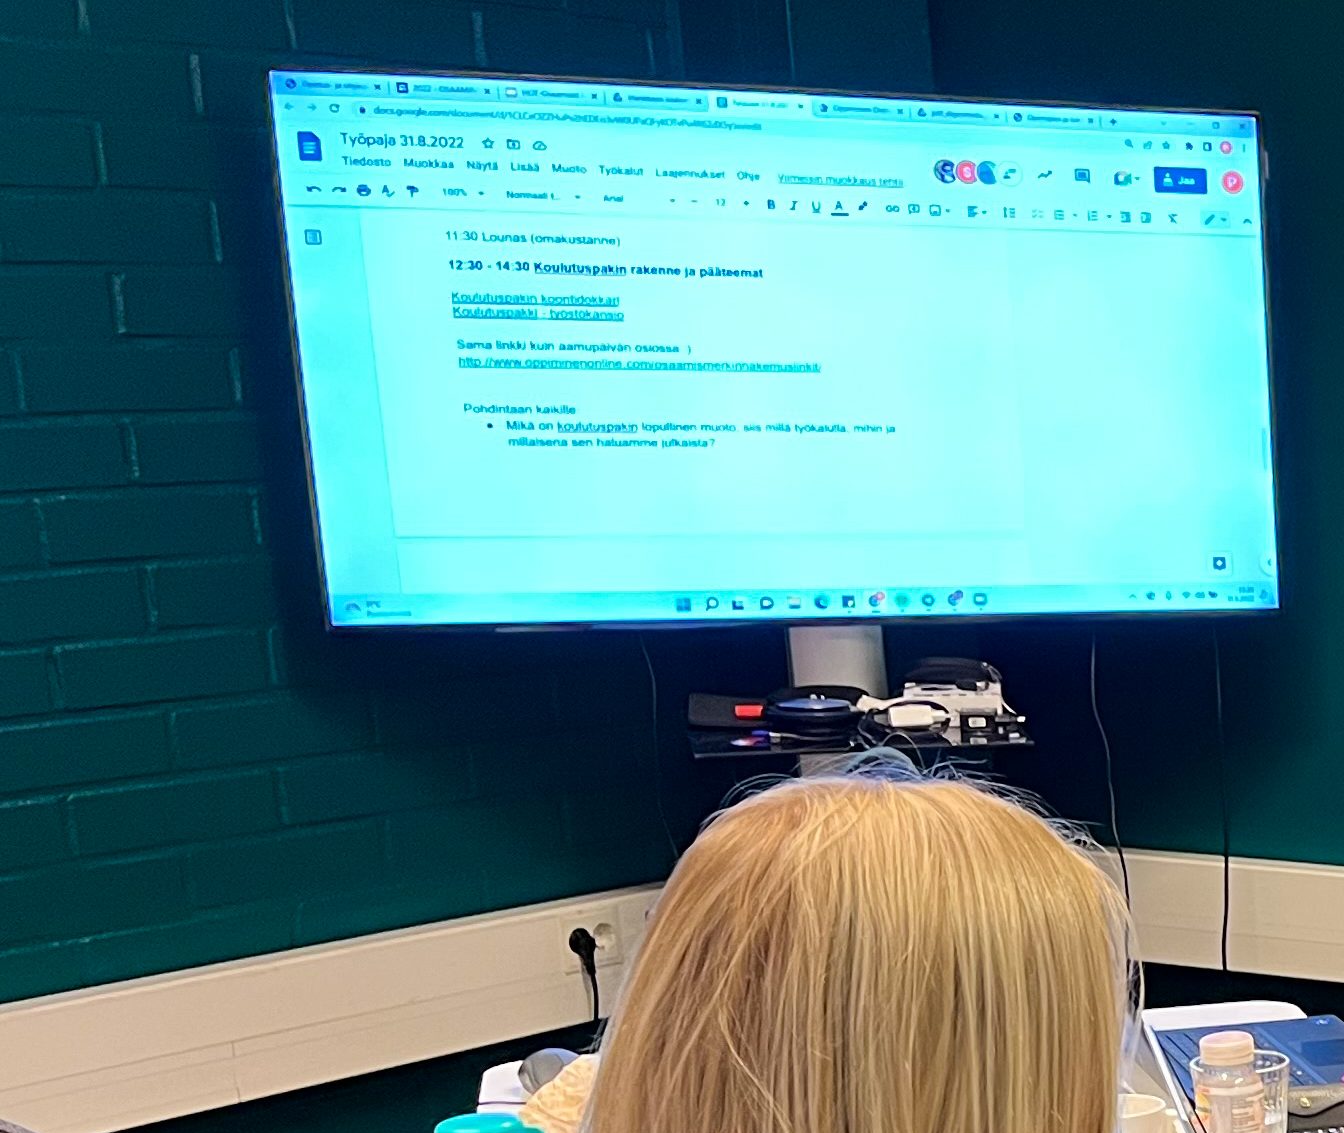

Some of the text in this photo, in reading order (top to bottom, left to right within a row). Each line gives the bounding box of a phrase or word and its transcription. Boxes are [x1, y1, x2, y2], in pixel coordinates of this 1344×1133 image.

[340, 132, 464, 149] Työpaja 31.8.2022
[342, 156, 392, 167] Tiedosto
[403, 158, 454, 169] Muokkaa
[551, 163, 587, 174] Muoto
[599, 164, 644, 177] Työkalut
[1177, 176, 1196, 185] Jaa
[482, 232, 527, 243] Lounas
[531, 234, 621, 247] (omakustanne)
[496, 261, 530, 272] 14:30
[534, 262, 627, 277] Koulutuspakin
[630, 265, 681, 276] rakenne
[684, 267, 696, 279] ja
[457, 339, 492, 350] Sama
[496, 339, 527, 350] linkki
[530, 341, 555, 351] kuin
[635, 344, 680, 353] osiossa
[464, 402, 533, 415] Pohdintaan
[539, 422, 553, 431] on
[558, 421, 638, 433] koulutuspakin
[642, 422, 697, 433] lopullinen
[886, 424, 896, 434] ja
[572, 438, 593, 447] sen
[597, 437, 658, 448] haluamme
